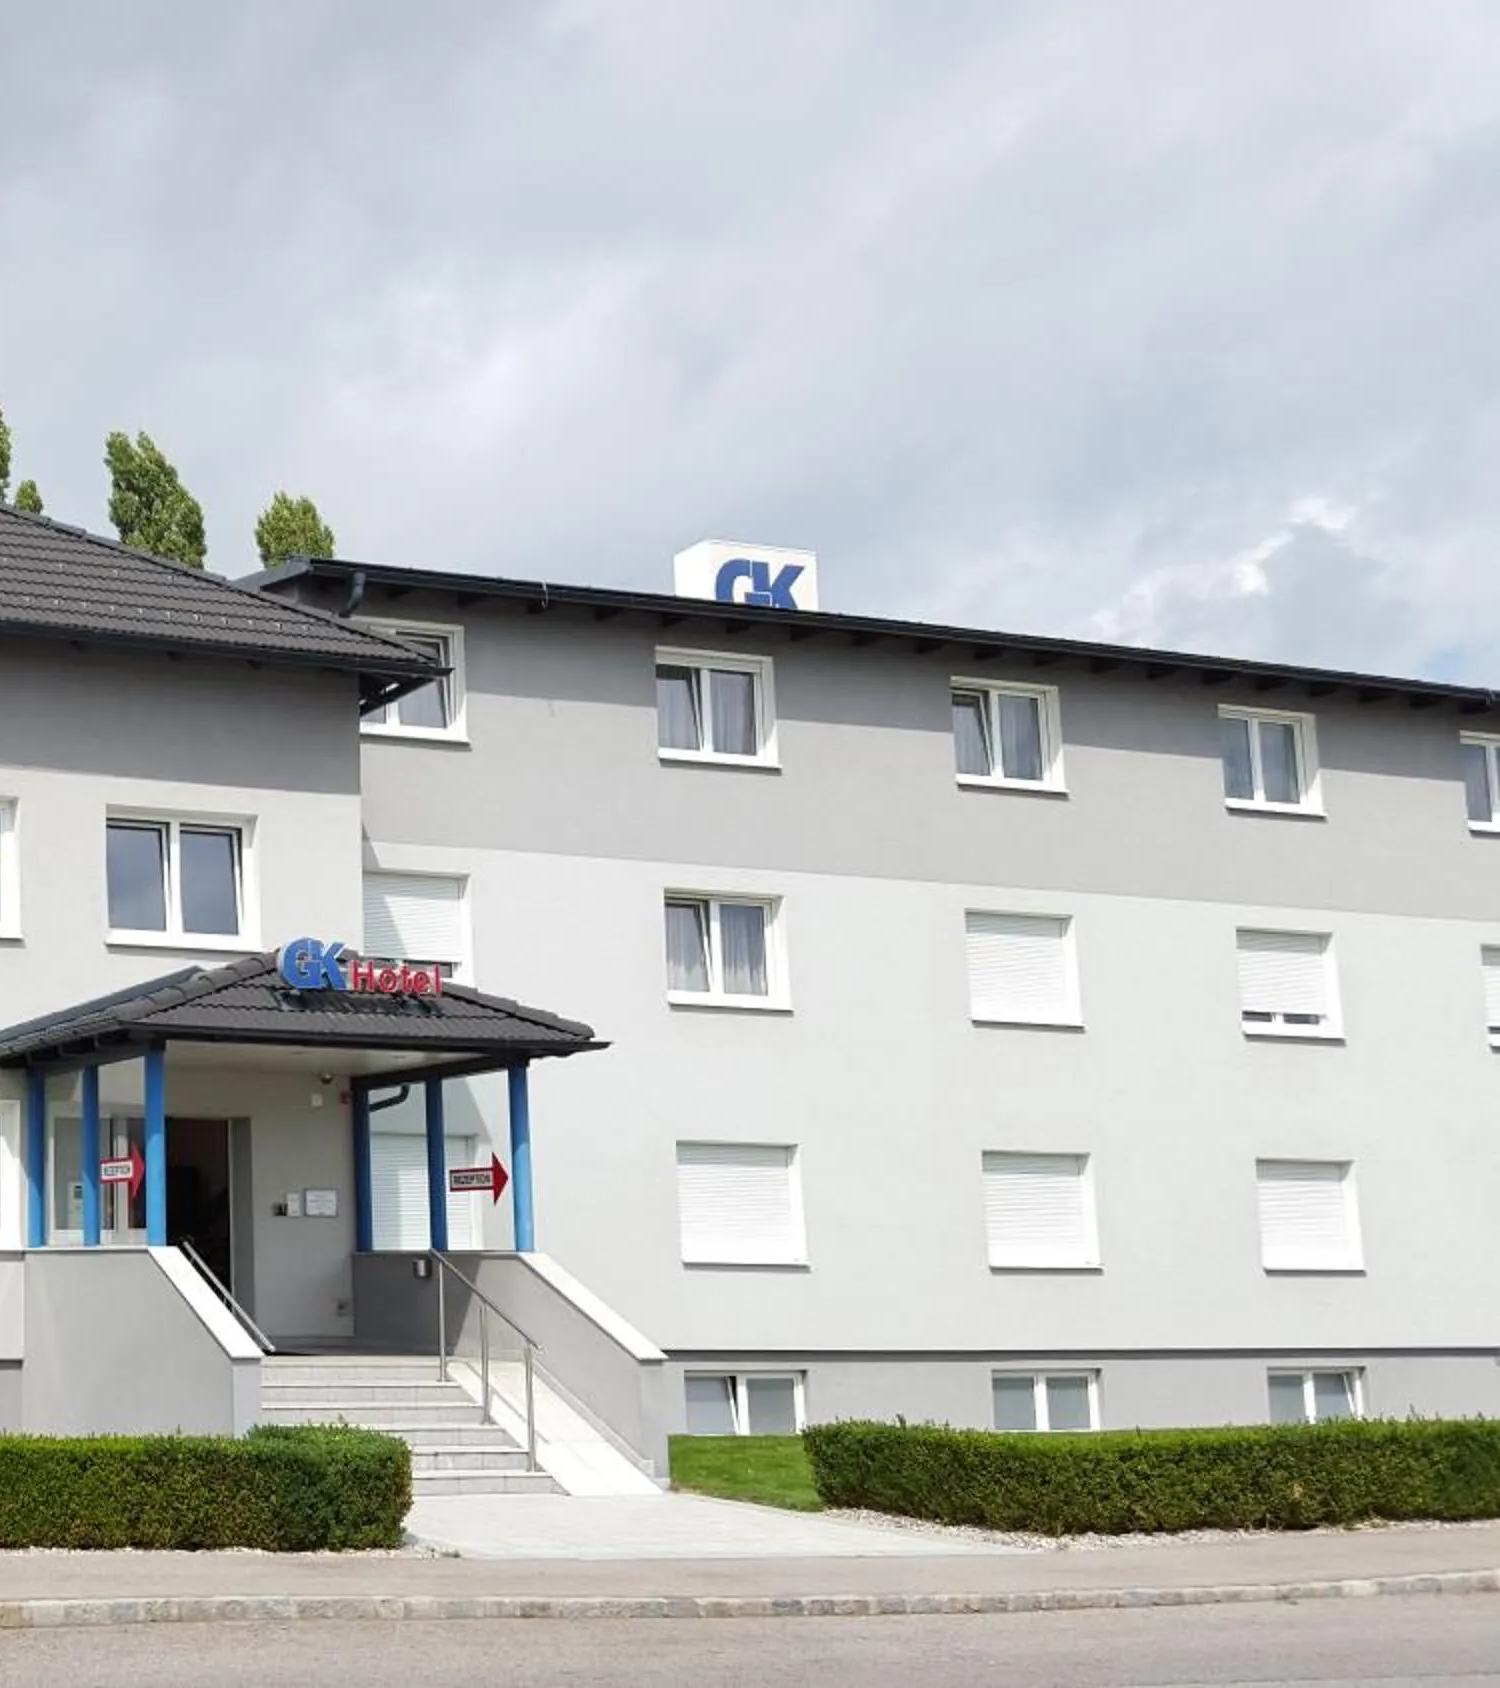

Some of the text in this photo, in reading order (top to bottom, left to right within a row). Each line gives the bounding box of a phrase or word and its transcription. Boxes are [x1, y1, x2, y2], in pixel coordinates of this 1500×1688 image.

[715, 558, 805, 611] GK
[279, 937, 443, 994] GK Hotel
